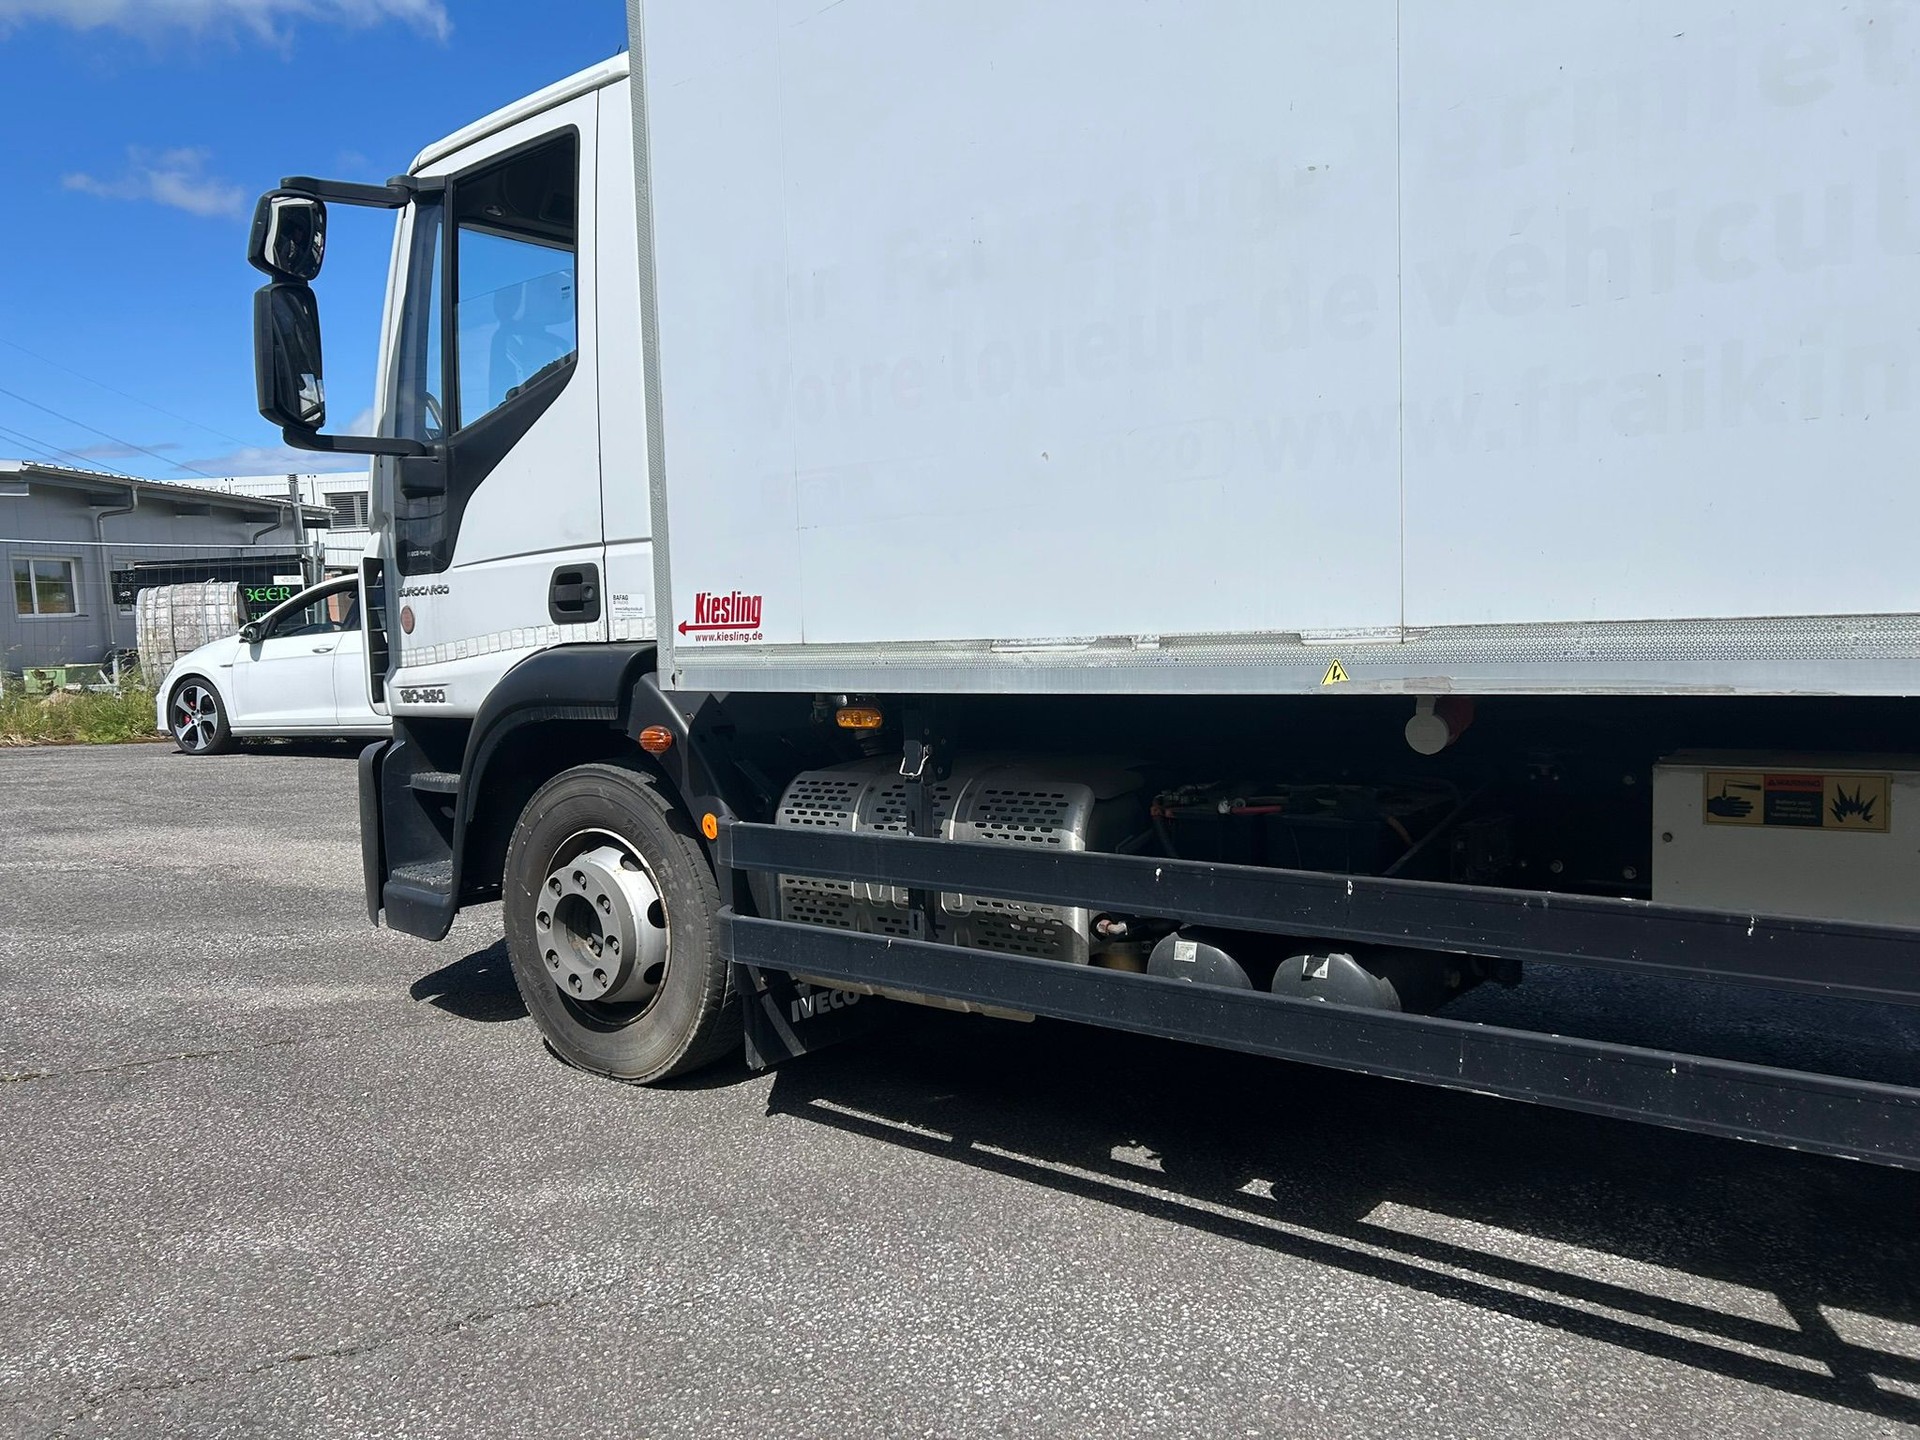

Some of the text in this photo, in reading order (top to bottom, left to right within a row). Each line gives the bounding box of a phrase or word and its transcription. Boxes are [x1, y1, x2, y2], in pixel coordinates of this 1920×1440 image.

[398, 585, 450, 598] EUROCARGO
[695, 590, 762, 627] Kiesling
[695, 631, 763, 643] www.kiesling.de
[790, 987, 861, 1024] IVECO
